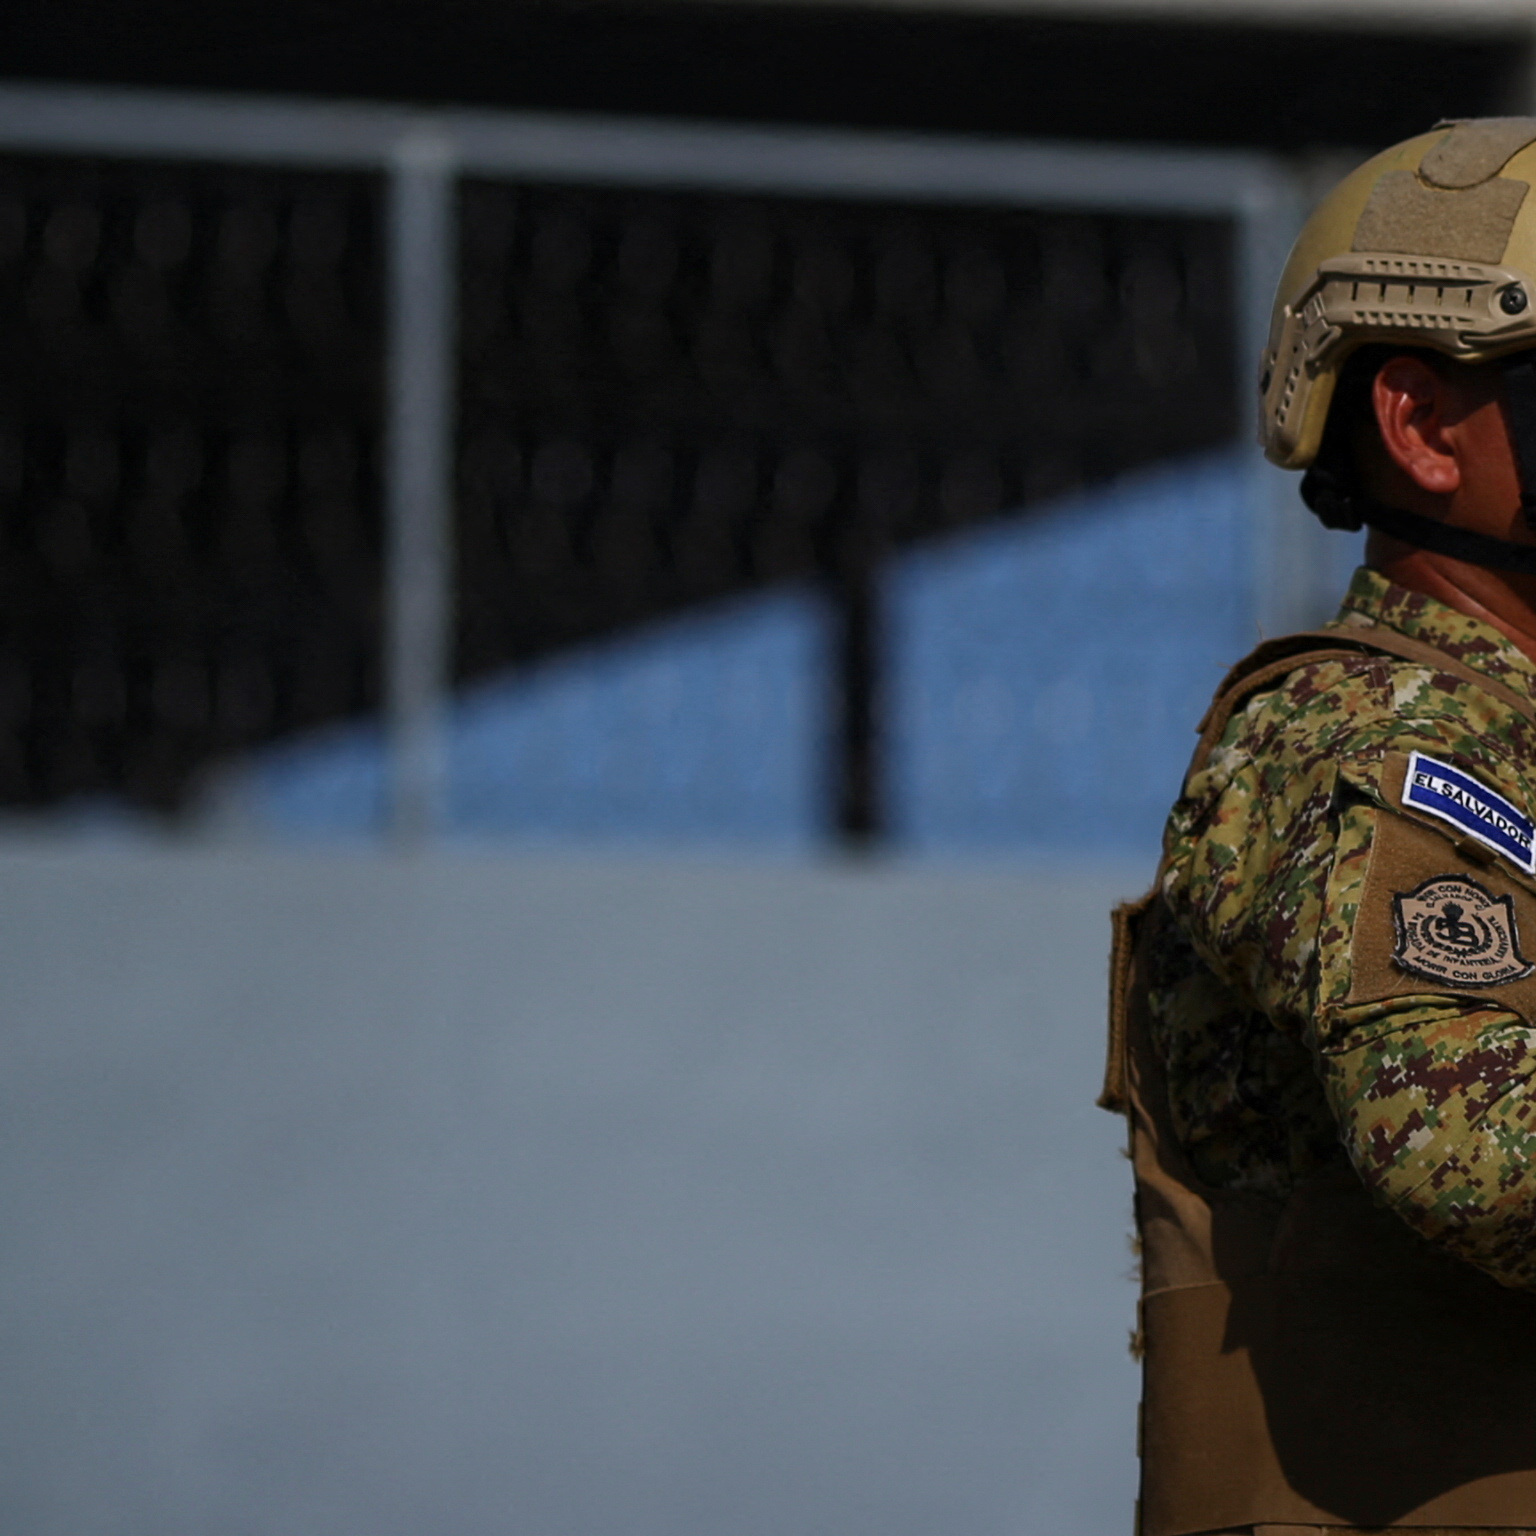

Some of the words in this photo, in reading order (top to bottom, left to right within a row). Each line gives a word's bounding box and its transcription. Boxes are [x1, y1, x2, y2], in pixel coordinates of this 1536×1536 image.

[1415, 773, 1438, 792] EL
[1441, 783, 1532, 849] SALVADOR
[1438, 885, 1462, 893] CON
[1412, 956, 1448, 975] MORIR
[1452, 970, 1478, 980] CON
[1482, 964, 1517, 980] GLORIA
